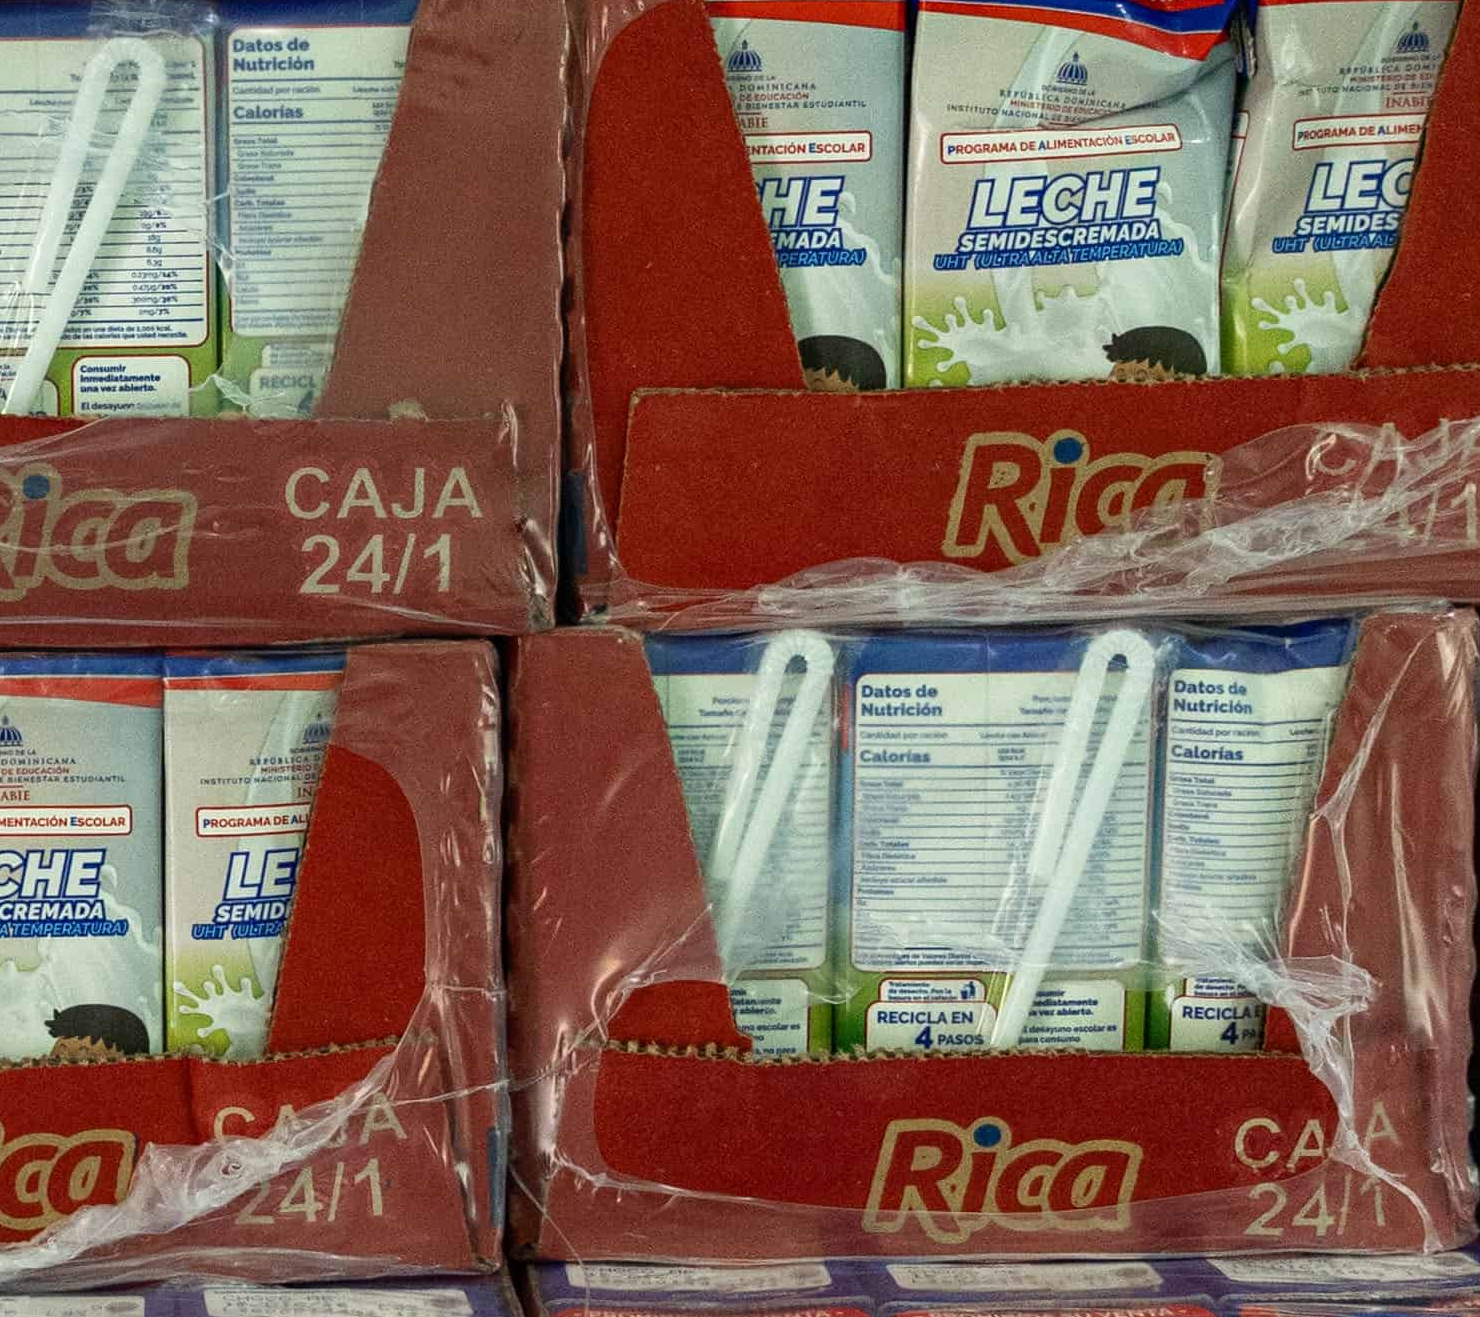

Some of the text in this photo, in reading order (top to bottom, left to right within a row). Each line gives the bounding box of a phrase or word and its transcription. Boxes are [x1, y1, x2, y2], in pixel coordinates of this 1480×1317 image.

[947, 134, 1176, 156] PROGRAMA DE ALIMENTACIÓN ESCOLAR
[967, 169, 1161, 226] LECHE
[958, 223, 1161, 250] SEMIDESCREMADA
[80, 365, 126, 373] Consumir
[284, 465, 484, 520] CAJA
[942, 429, 1220, 564] Rica
[299, 533, 453, 595] 24/1
[861, 685, 938, 698] Datos de
[861, 703, 943, 717] Nutrición
[70, 817, 126, 827] ESCOLAR
[877, 1011, 974, 1024] RECICLA EN
[914, 1026, 985, 1049] 4 PASOS
[1234, 1102, 1397, 1166] CAA
[235, 1158, 385, 1222] 24/1
[863, 1117, 1143, 1243] Rica
[1245, 1179, 1386, 1239] 24/1
